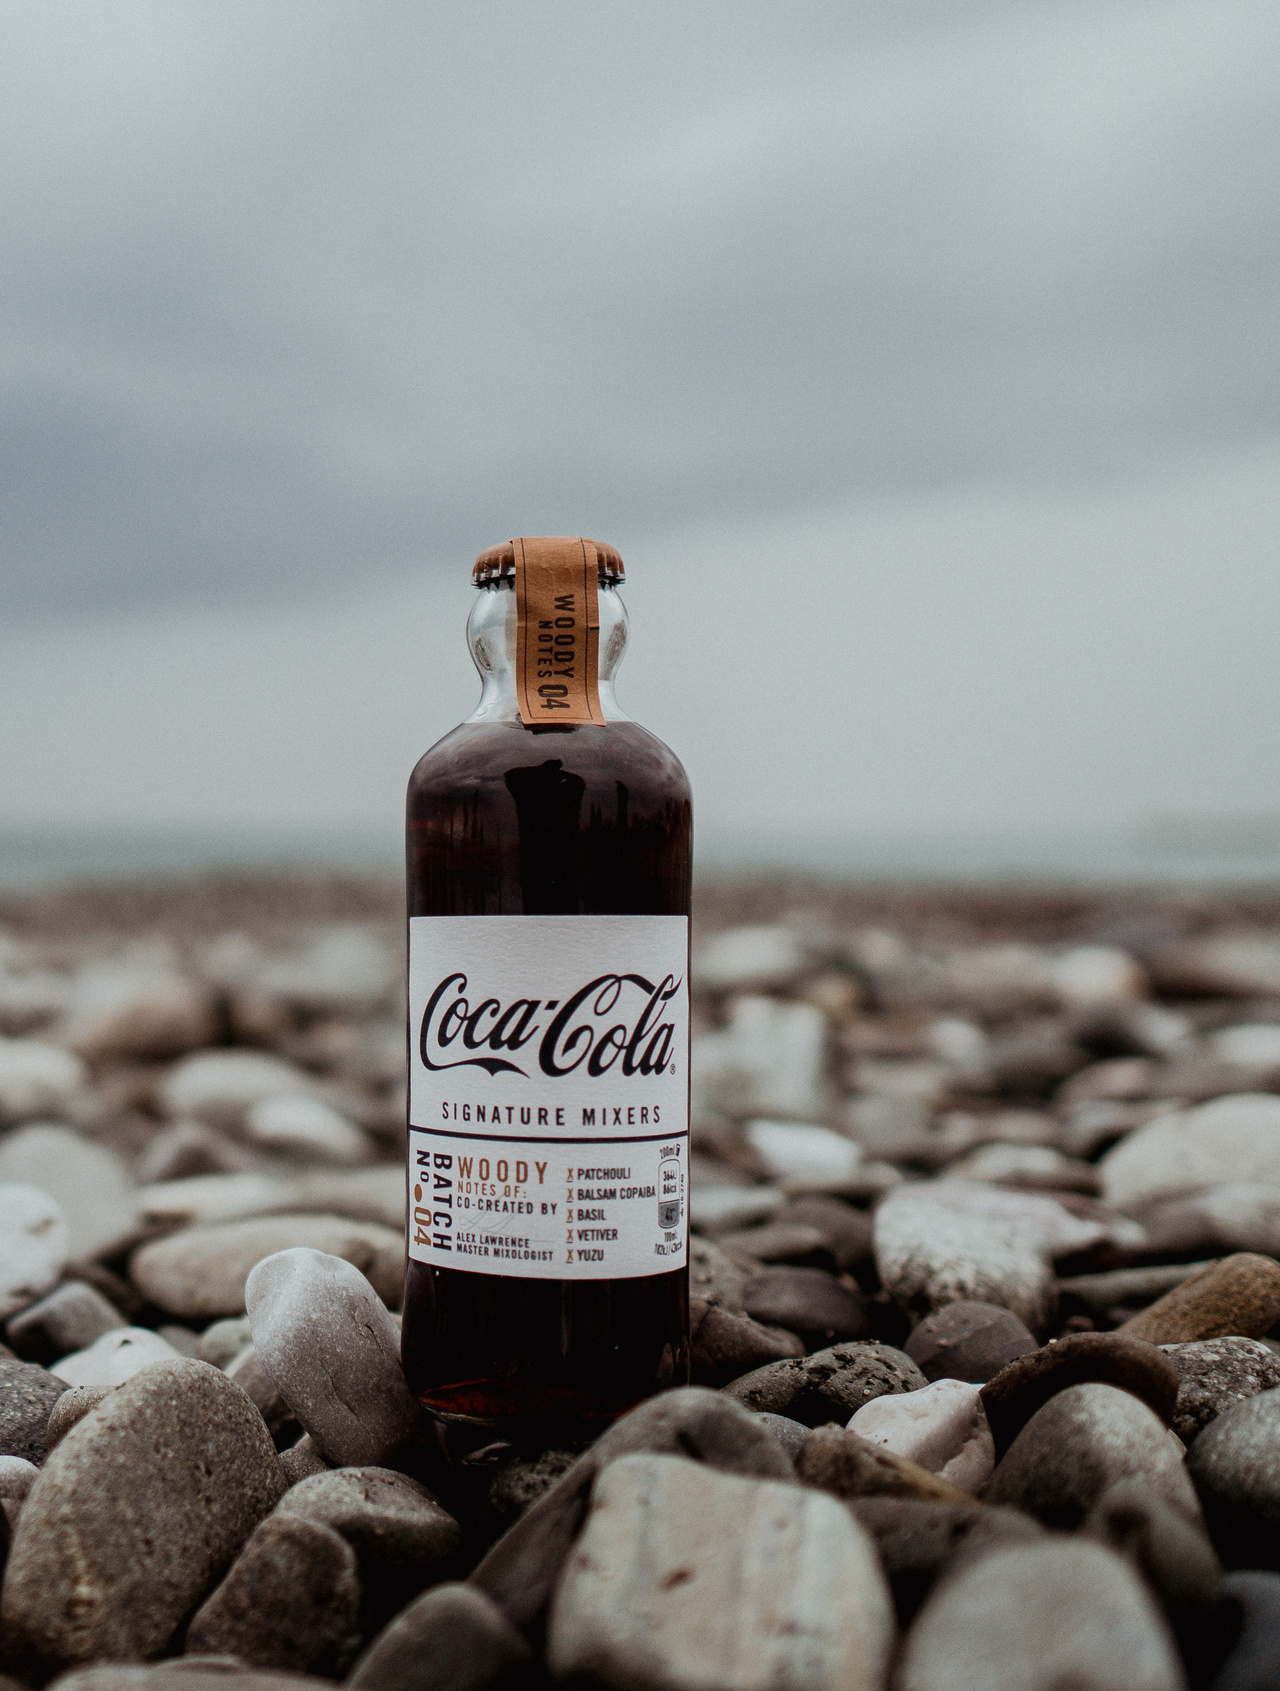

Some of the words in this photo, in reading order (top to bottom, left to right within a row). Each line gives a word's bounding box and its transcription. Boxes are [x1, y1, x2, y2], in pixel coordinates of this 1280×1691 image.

[554, 594, 575, 678] WOODY
[537, 620, 553, 678] NOTES
[537, 684, 570, 710] 04
[420, 972, 683, 1079] Coca-Cola
[442, 1101, 565, 1126] SIGNATURE
[582, 1105, 661, 1126] MIXERS
[457, 1155, 548, 1184] WOODY
[577, 1167, 631, 1180] PATCHOULI
[457, 1180, 496, 1197] NOTES
[503, 1185, 527, 1198] OF:
[577, 1188, 617, 1201] BALSAM
[620, 1186, 656, 1199] COPAIBA
[432, 1153, 453, 1251] BATCH
[456, 1196, 534, 1214] CO-CREATED
[541, 1202, 558, 1215] BY
[577, 1208, 606, 1221] BASIL
[413, 1206, 432, 1246] 04
[577, 1229, 619, 1241] VETIVER
[456, 1231, 476, 1243] ALEX
[479, 1233, 530, 1248] LAWRENCE
[456, 1243, 489, 1256] MASTER
[493, 1247, 554, 1261] MIXOLOGIST
[577, 1249, 604, 1262] YUZU
